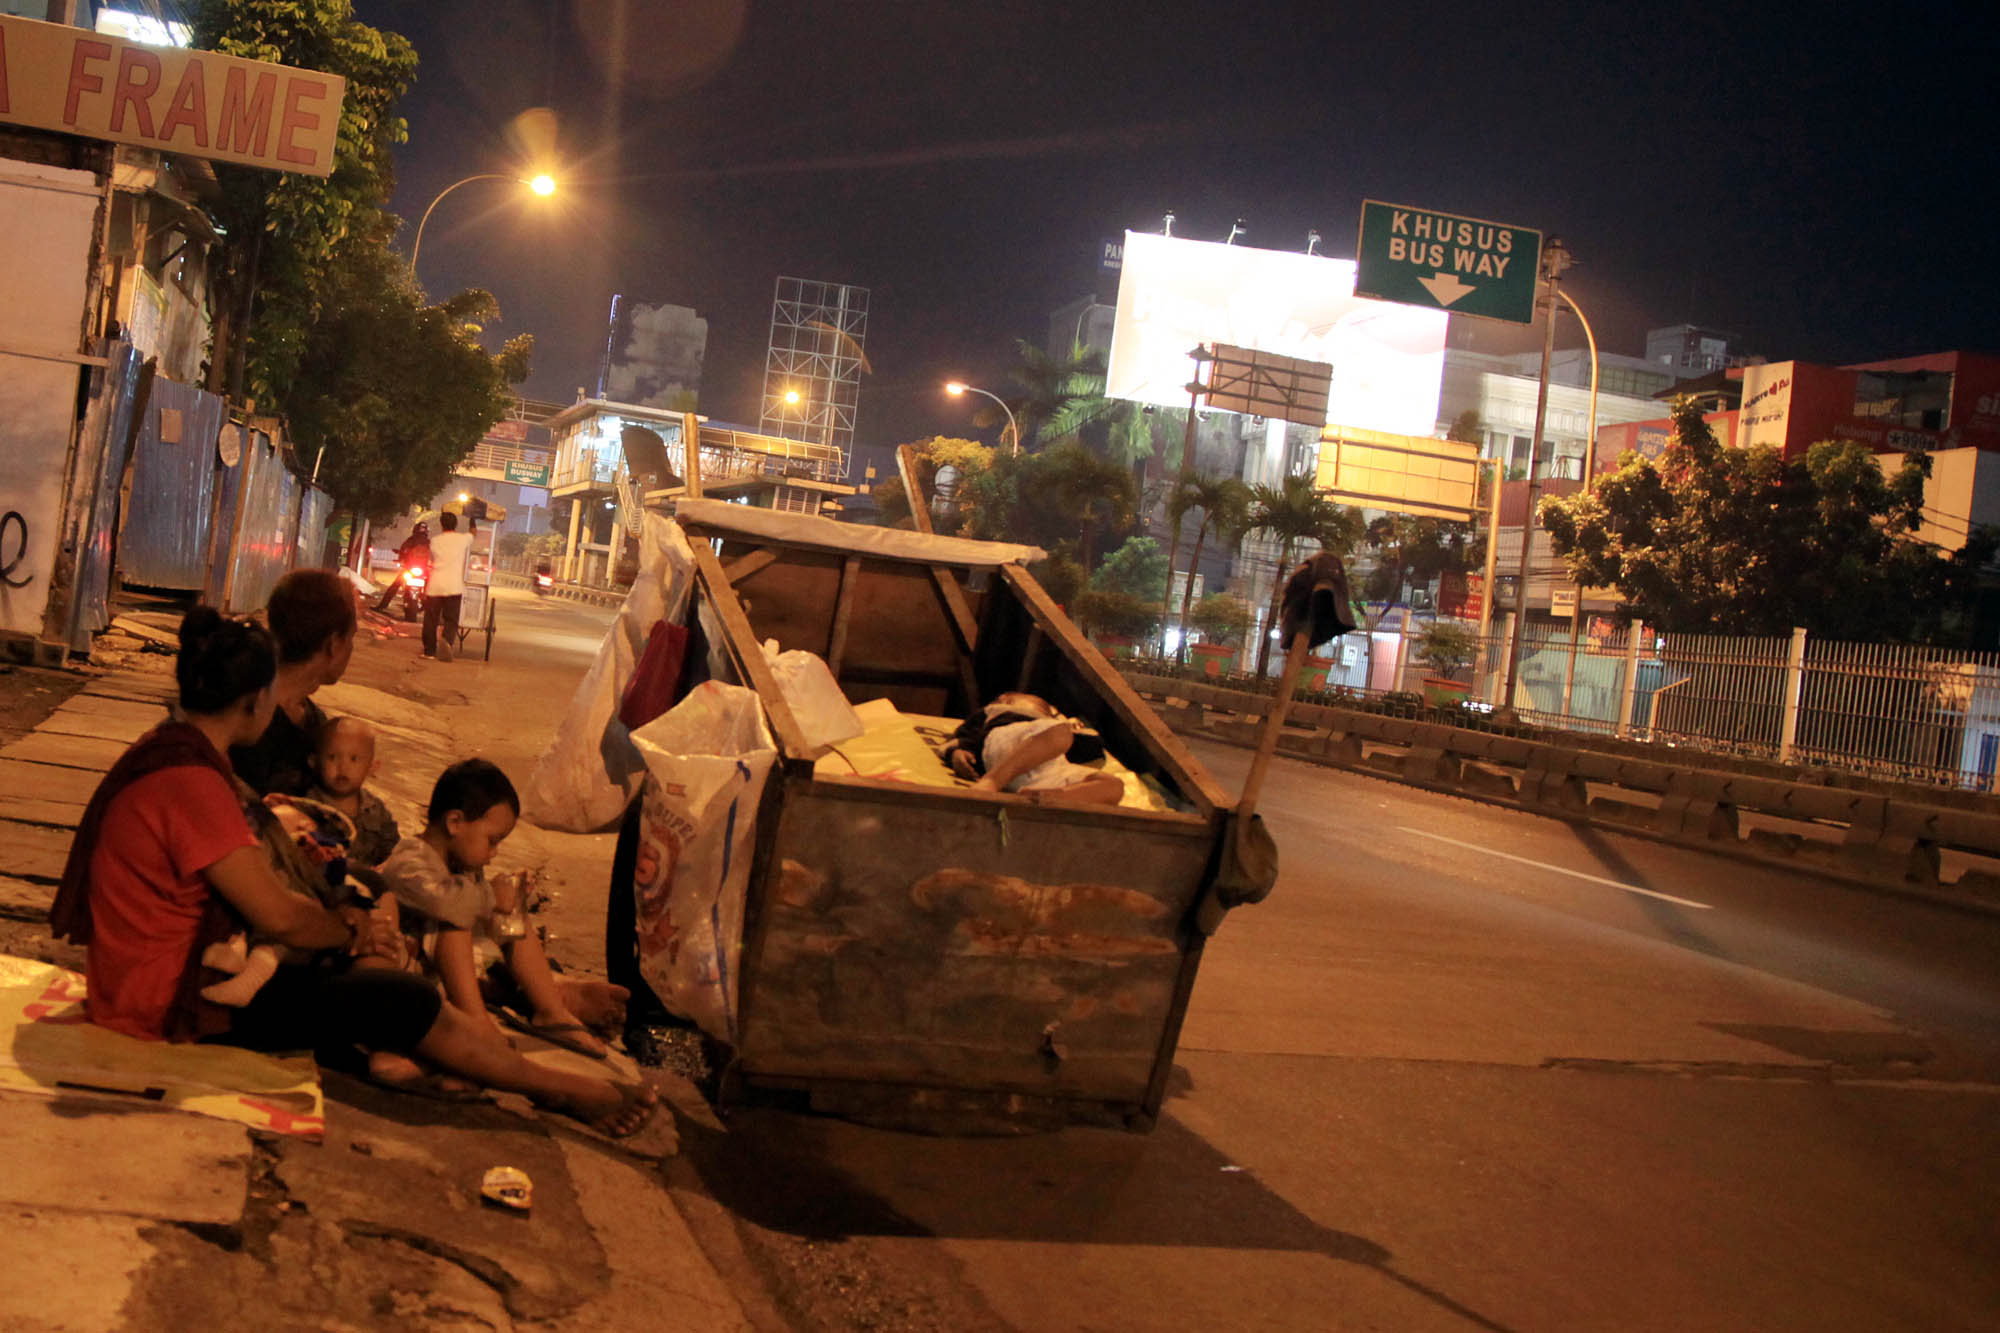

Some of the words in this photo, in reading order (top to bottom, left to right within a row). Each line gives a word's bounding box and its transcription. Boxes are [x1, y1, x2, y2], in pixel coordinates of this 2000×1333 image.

[62, 39, 327, 166] FRAME
[1391, 210, 1513, 253] KHUSUS
[1388, 236, 1444, 268] BUS
[1454, 247, 1511, 279] WAY
